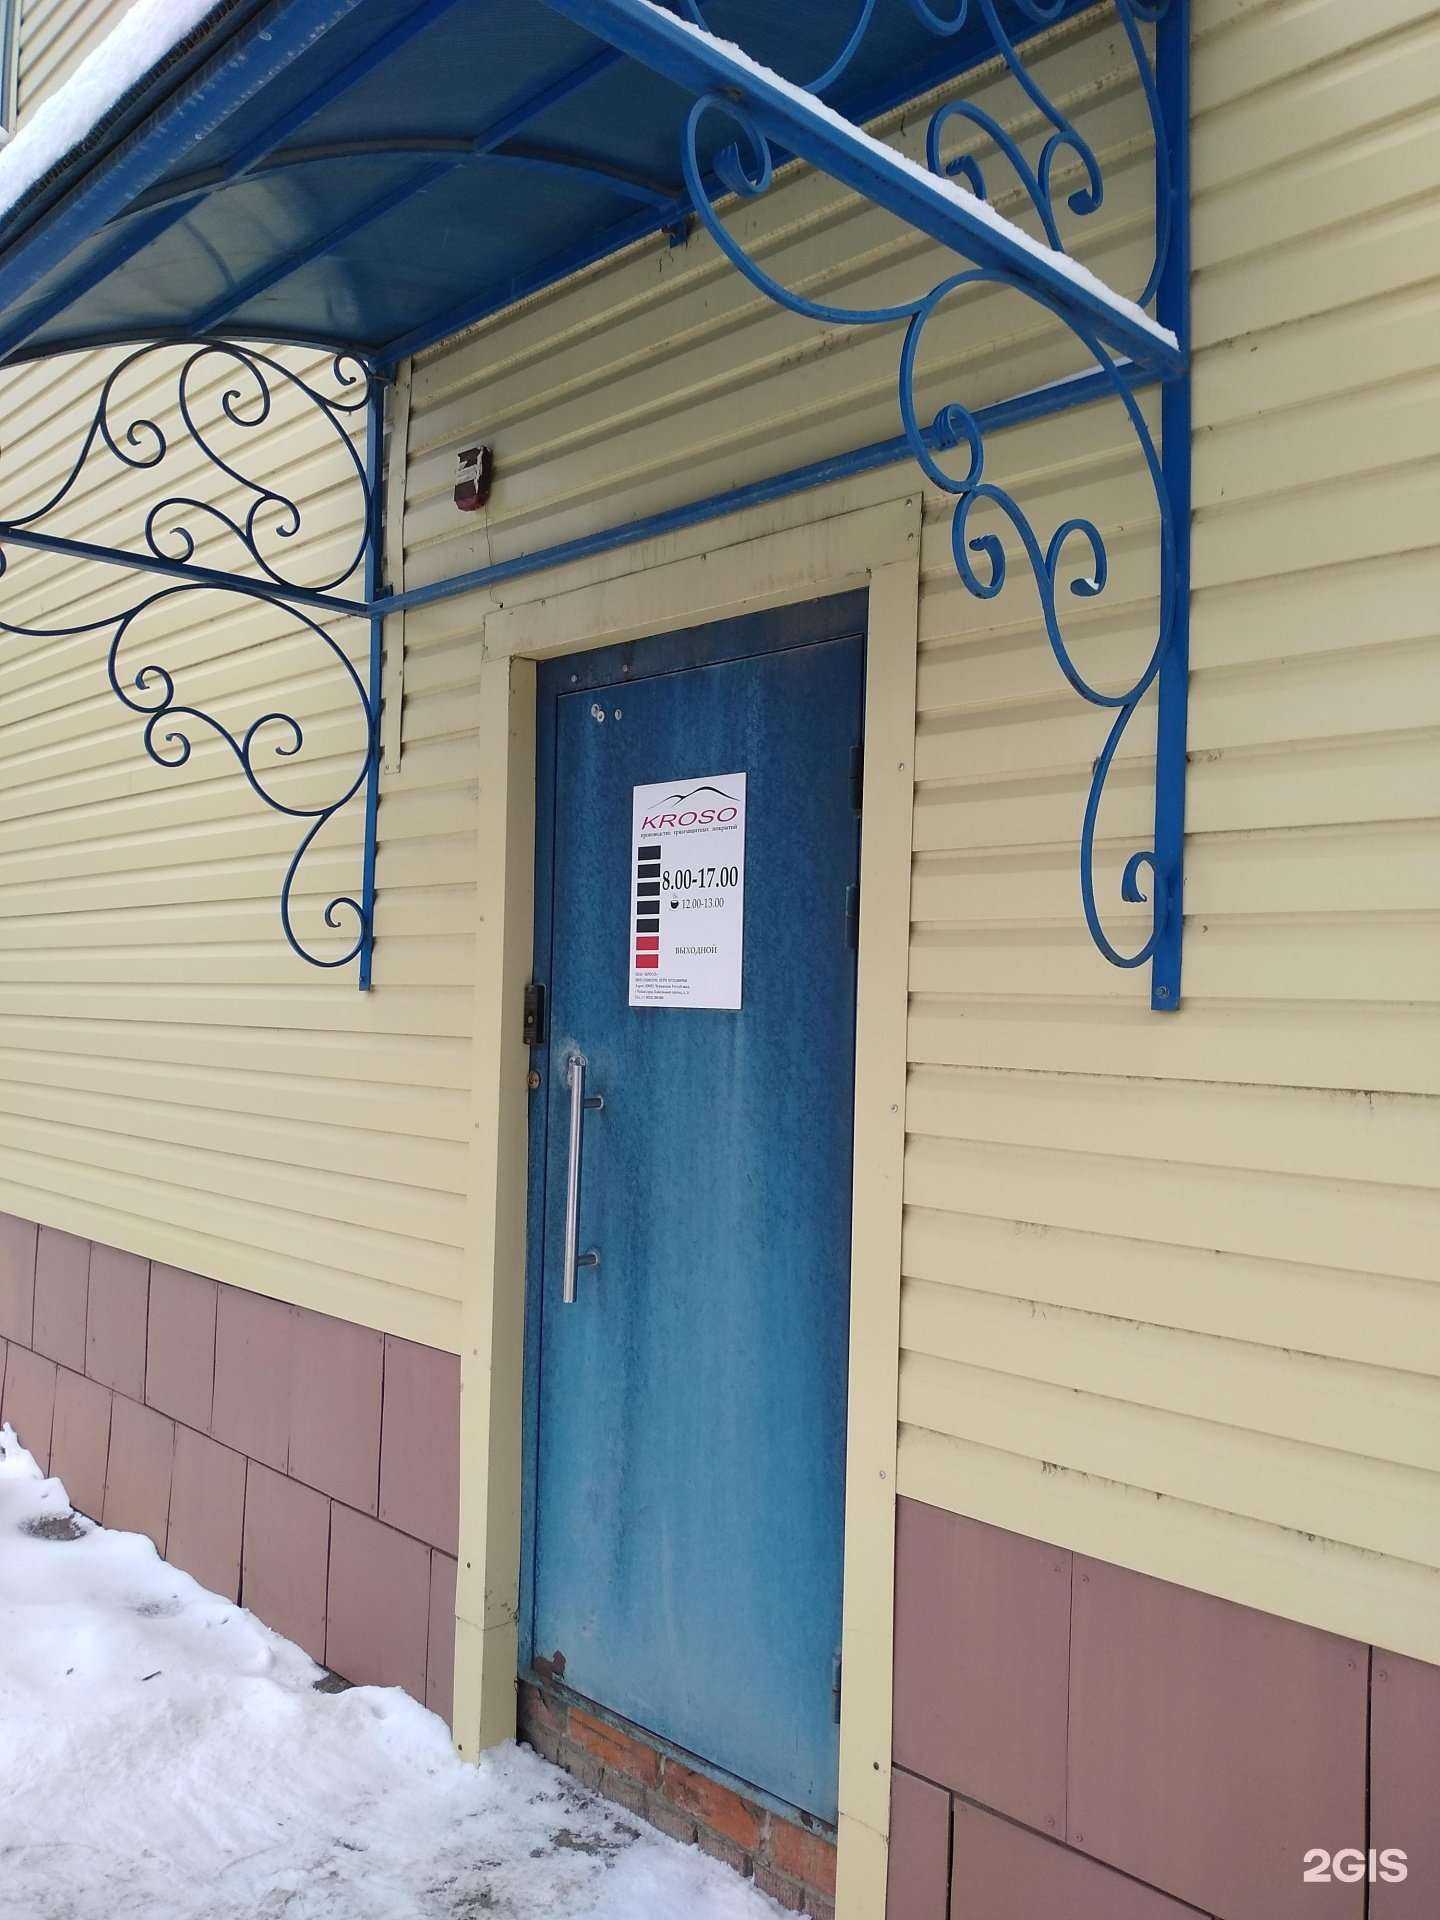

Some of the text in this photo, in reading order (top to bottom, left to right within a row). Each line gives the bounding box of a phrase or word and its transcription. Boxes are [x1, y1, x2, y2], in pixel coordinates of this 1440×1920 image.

[641, 807, 738, 831] KROSO
[662, 866, 739, 891] 8.00-17.00
[682, 897, 725, 909] 12.00-13.00
